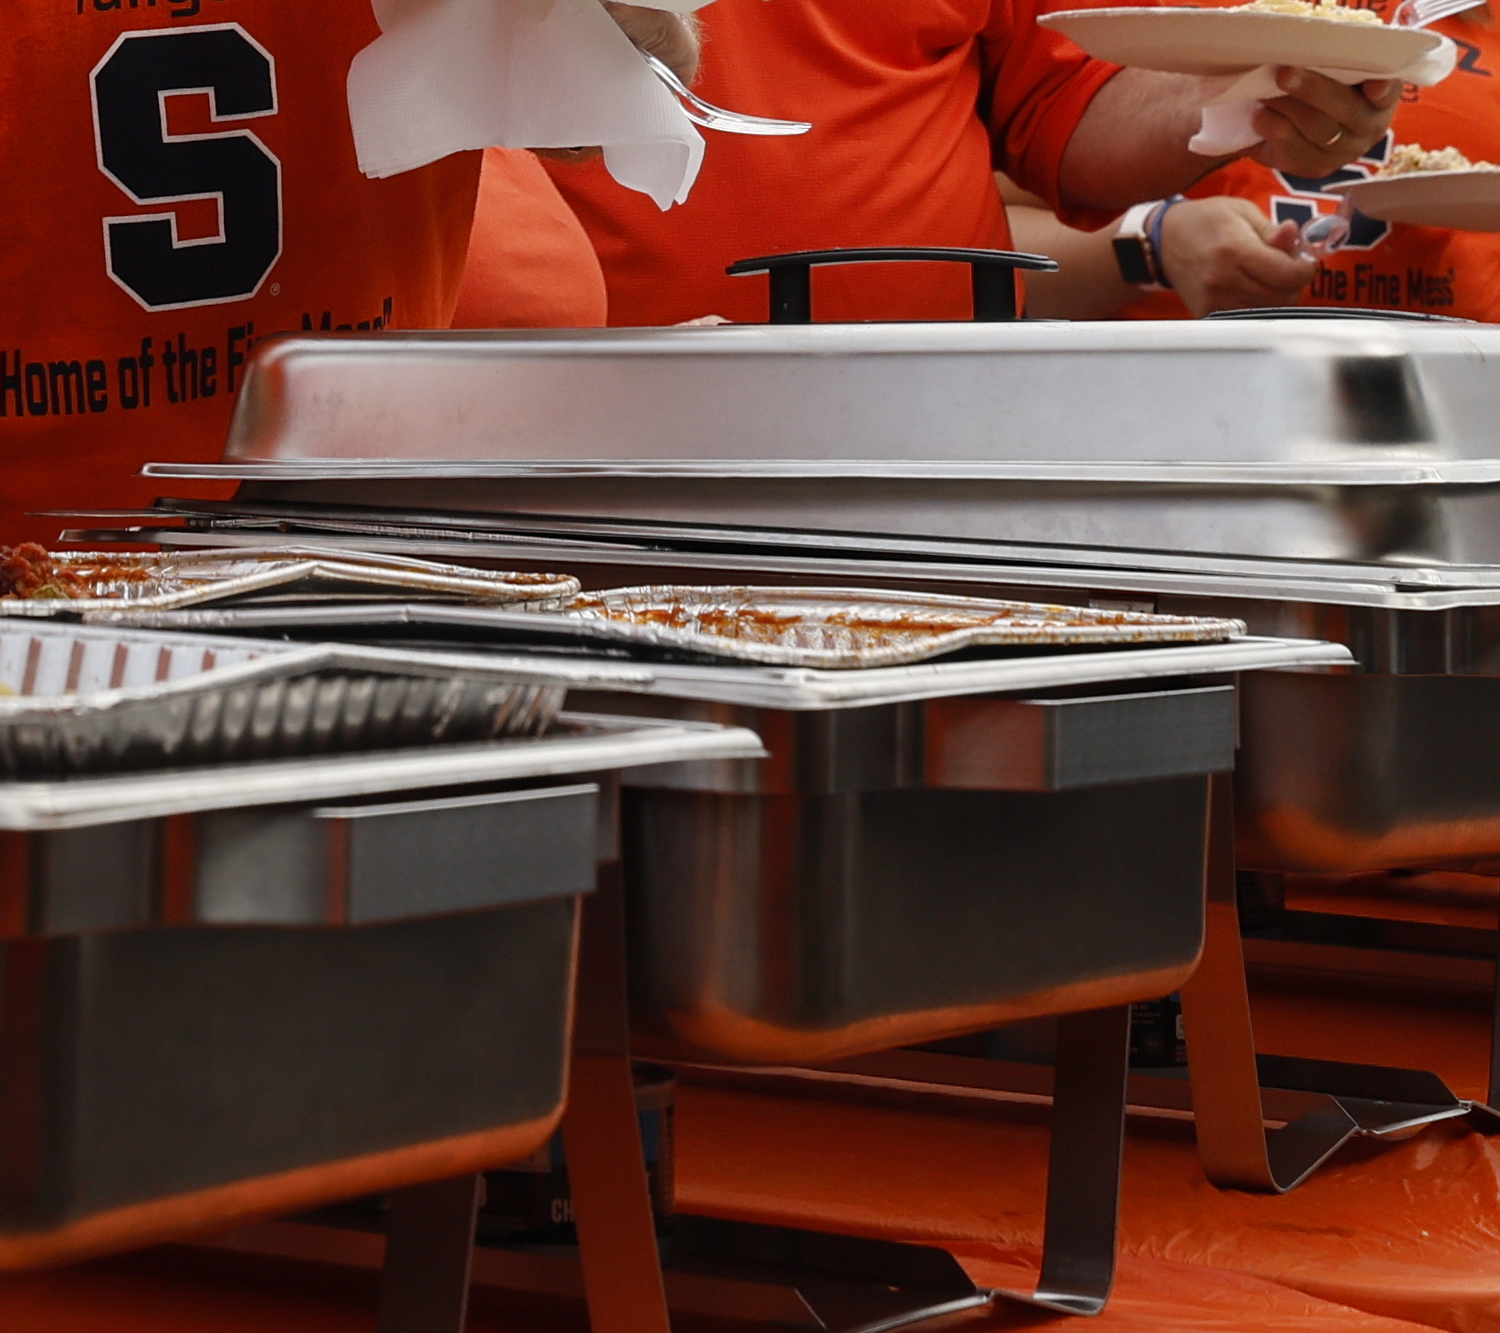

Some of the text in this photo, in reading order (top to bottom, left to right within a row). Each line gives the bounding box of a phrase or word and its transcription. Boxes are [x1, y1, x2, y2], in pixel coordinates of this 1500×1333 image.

[89, 22, 283, 312] S
[1354, 263, 1401, 306] Fine
[118, 337, 154, 409] of
[162, 333, 217, 405] the
